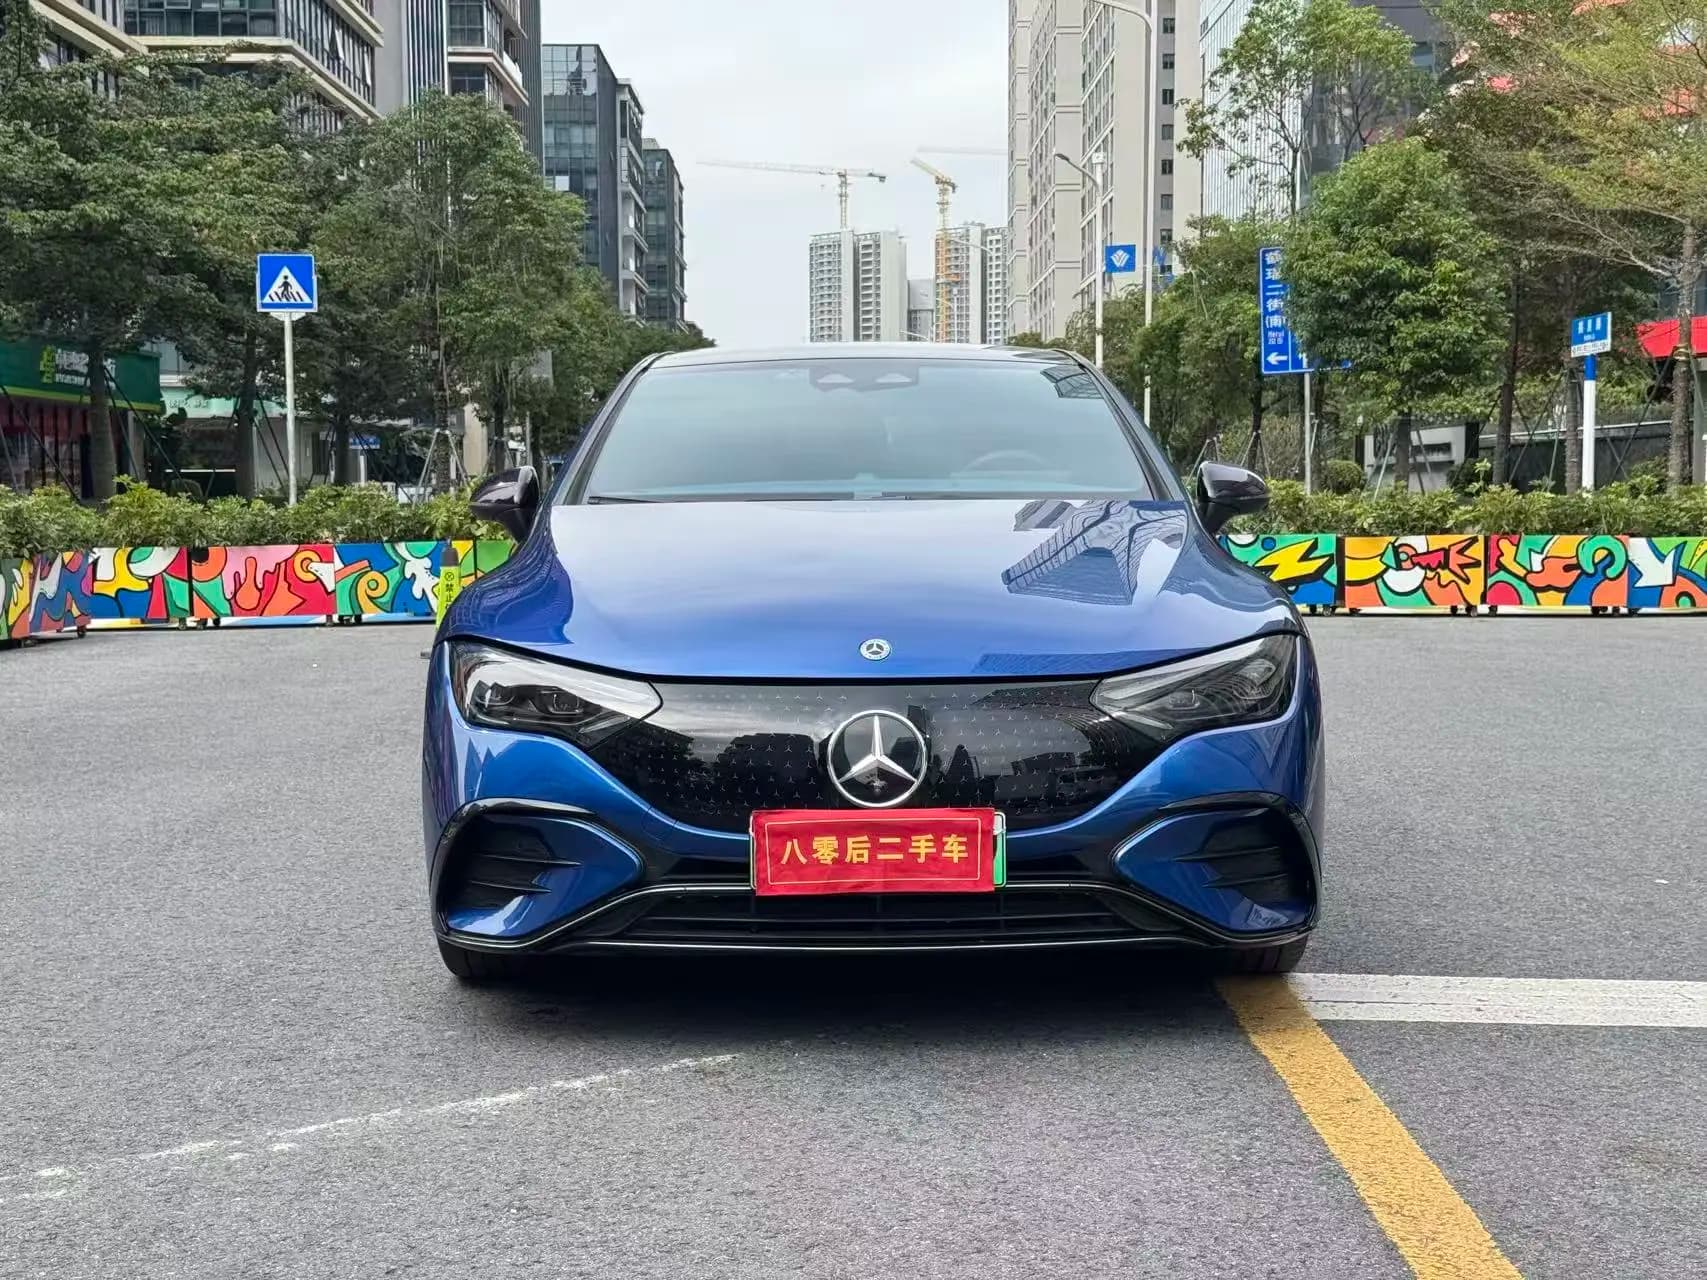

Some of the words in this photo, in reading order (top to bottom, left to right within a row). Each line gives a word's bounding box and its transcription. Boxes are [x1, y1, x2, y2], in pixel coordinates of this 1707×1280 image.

[780, 834, 969, 865] 八零后二手车
